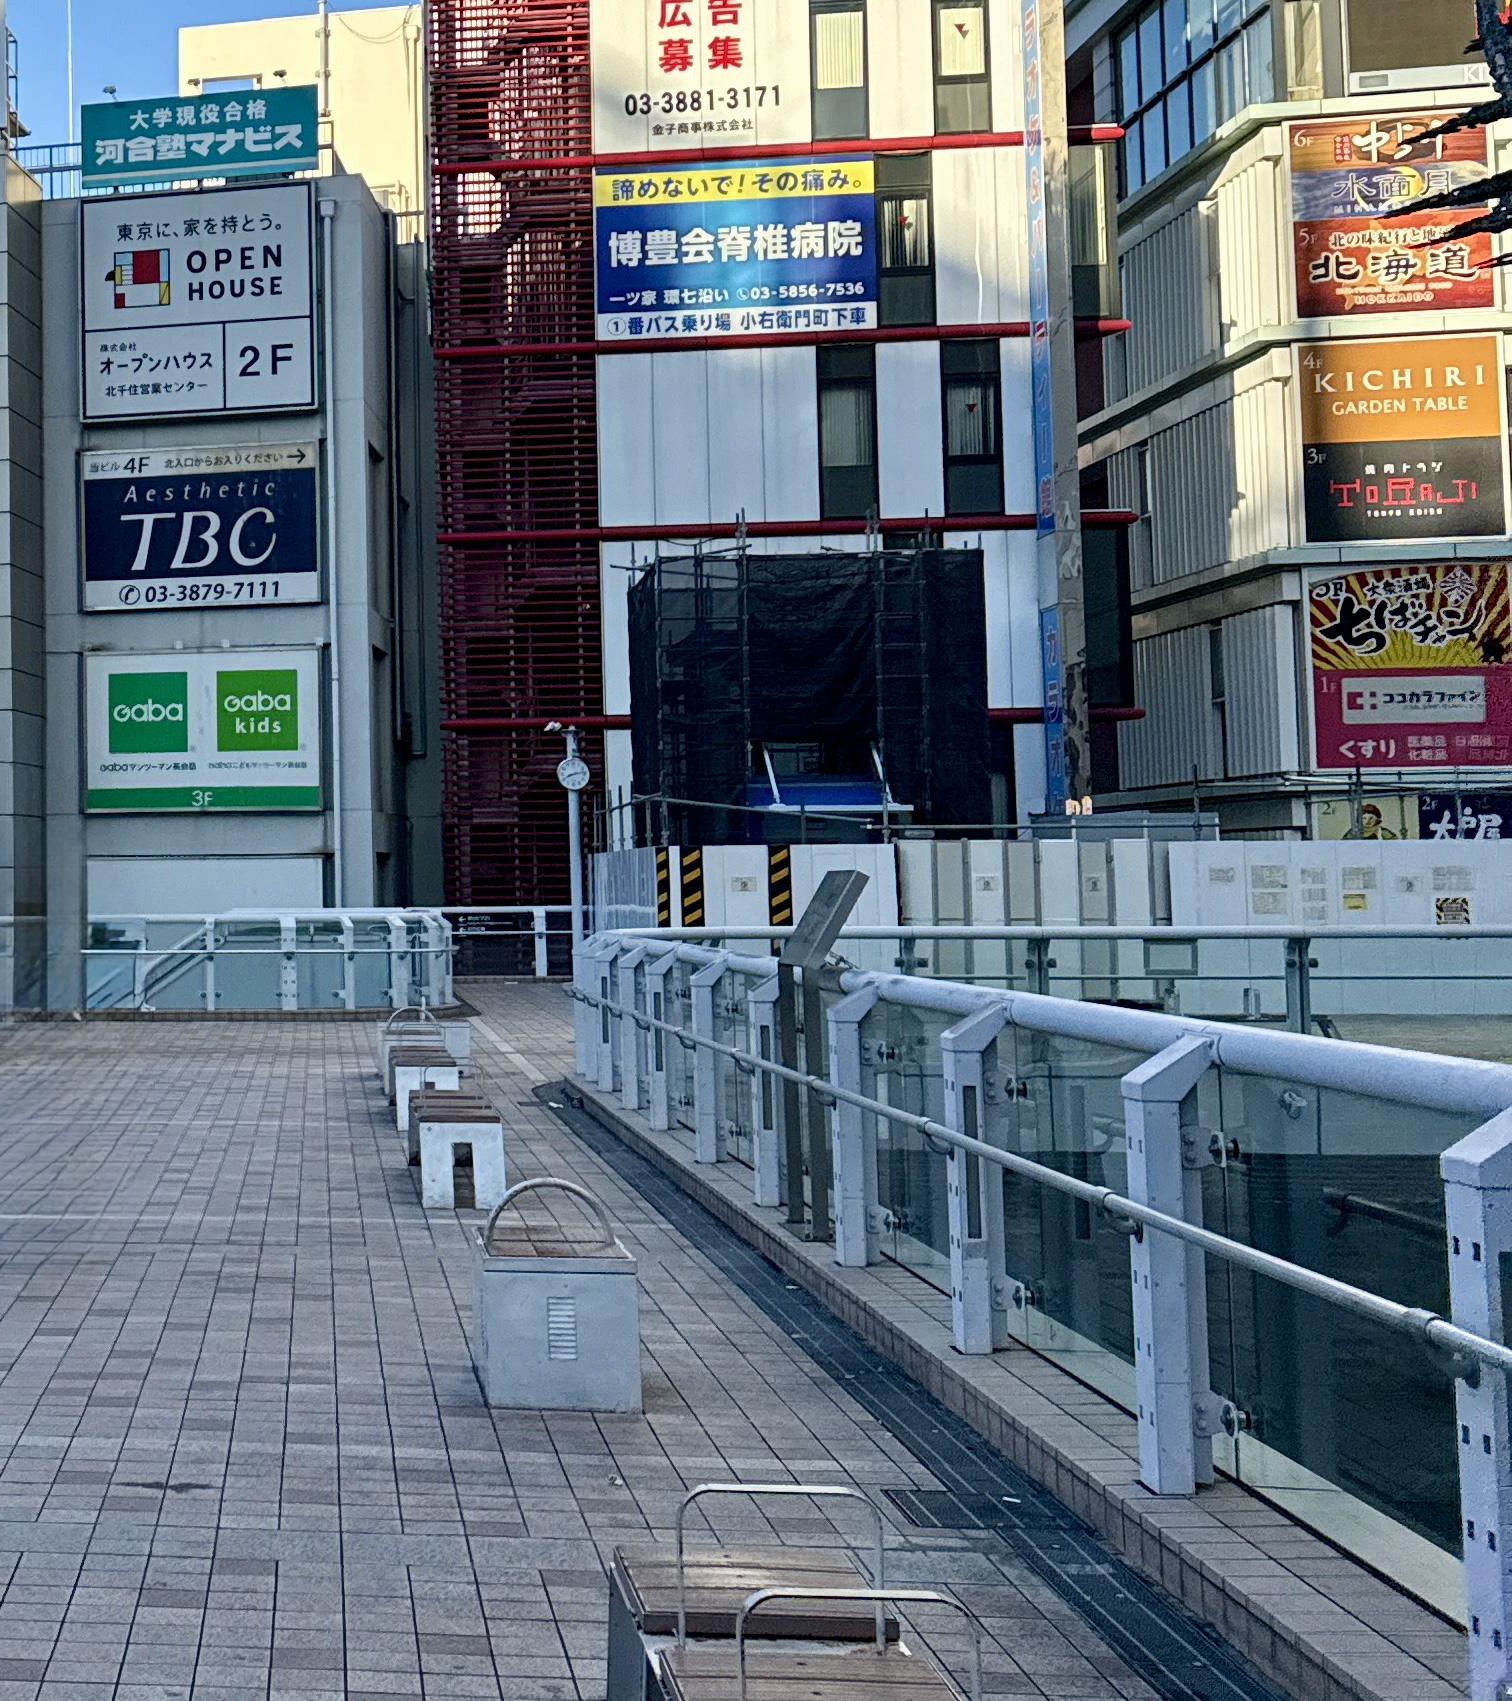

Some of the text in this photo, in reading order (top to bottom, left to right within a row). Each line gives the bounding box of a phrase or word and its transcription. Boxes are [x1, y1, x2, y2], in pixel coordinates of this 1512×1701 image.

[658, 0, 742, 29] 広告
[658, 36, 743, 73] 募集
[624, 85, 781, 116] 03-3881-3171
[129, 99, 267, 131] 大学現役合格
[652, 118, 754, 136] 金子商事株式会社
[1293, 130, 1314, 147] 6F
[95, 123, 304, 165] 河合塾マナビス
[117, 213, 282, 242] 東京に、家を持とう。
[609, 220, 863, 268] 博豊会脊椎病院
[186, 244, 282, 273] OPEN
[1311, 246, 1478, 283] 北海道
[188, 276, 283, 301] HOUSE
[664, 287, 729, 305] 環七沿い
[750, 282, 865, 300] 03-5856-7536
[740, 307, 867, 330] 小右衛門町下車
[100, 342, 137, 353] 株式会社
[100, 352, 213, 375] オープンハウス
[239, 343, 294, 377] 2F
[1303, 352, 1323, 369] 4F
[105, 381, 208, 397] 北千住営業センター
[1315, 364, 1485, 393] KICHIRI
[1332, 396, 1468, 415] GARDEN TABLE
[89, 461, 120, 473] 当ビル
[123, 456, 150, 474] 4F
[1307, 448, 1327, 465] 3F
[124, 480, 276, 503] Aesthetic
[120, 506, 276, 571] TBC
[145, 580, 280, 603] 03-3879-7111
[235, 717, 282, 733] kids
[1339, 739, 1396, 759] くすり
[191, 790, 214, 807] 3F
